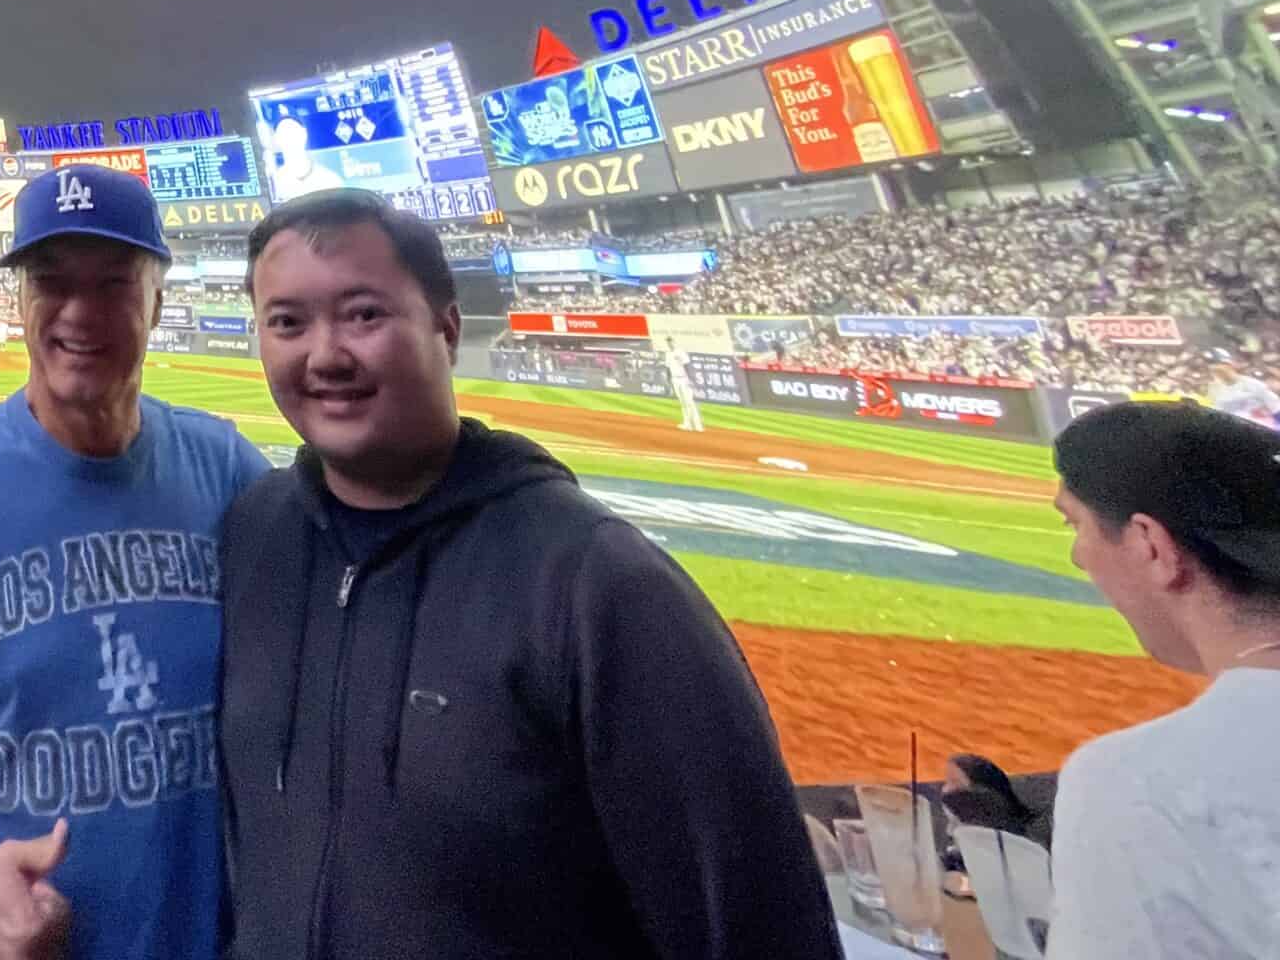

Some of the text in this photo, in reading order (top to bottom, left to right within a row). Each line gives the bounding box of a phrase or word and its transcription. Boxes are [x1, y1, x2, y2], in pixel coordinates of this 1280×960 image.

[644, 26, 757, 86] STARR
[772, 64, 816, 88] This
[780, 81, 833, 107] Bud's
[17, 121, 104, 151] YANKEE
[115, 108, 223, 145] STADIUM
[672, 107, 765, 153] DKNY
[787, 106, 820, 126] For
[793, 126, 839, 145] You.
[56, 169, 94, 213] LA
[557, 153, 644, 200] razr
[187, 202, 265, 225] DELTA
[567, 319, 598, 330] TOYOTA
[770, 380, 1003, 418] BAD BOY MOWERS
[93, 612, 160, 715] LA
